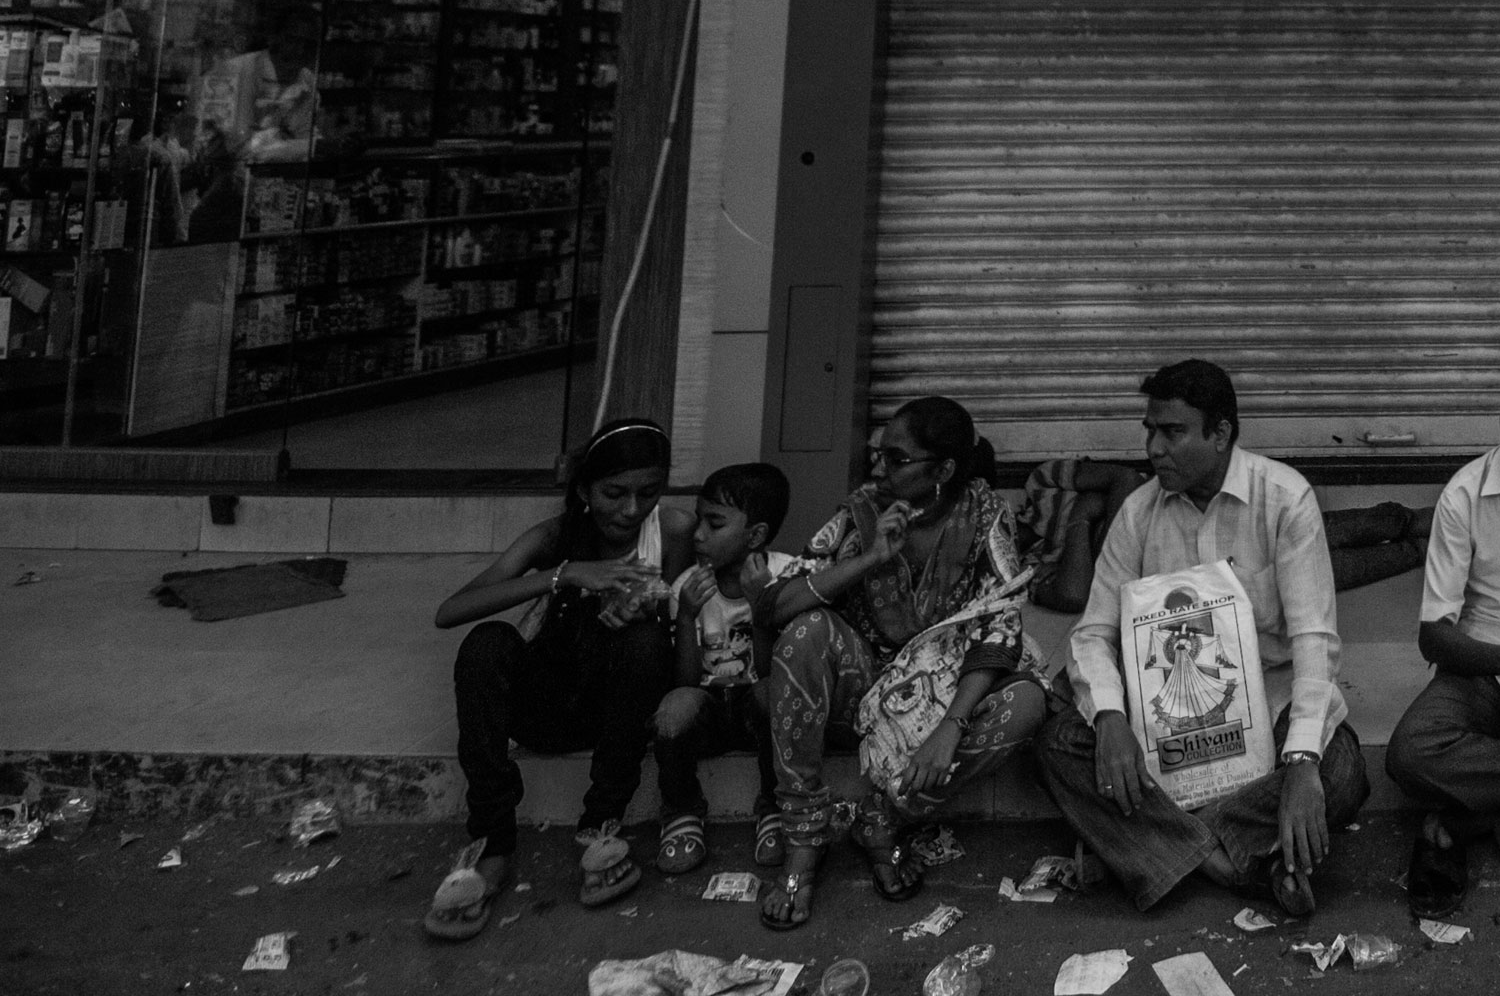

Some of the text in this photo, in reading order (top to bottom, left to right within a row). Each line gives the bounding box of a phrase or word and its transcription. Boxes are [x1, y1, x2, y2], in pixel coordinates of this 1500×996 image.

[1133, 595, 1235, 623] FIXED RATE SHOP
[1162, 730, 1241, 766] Shivam
[1186, 742, 1243, 761] COLLECTION
